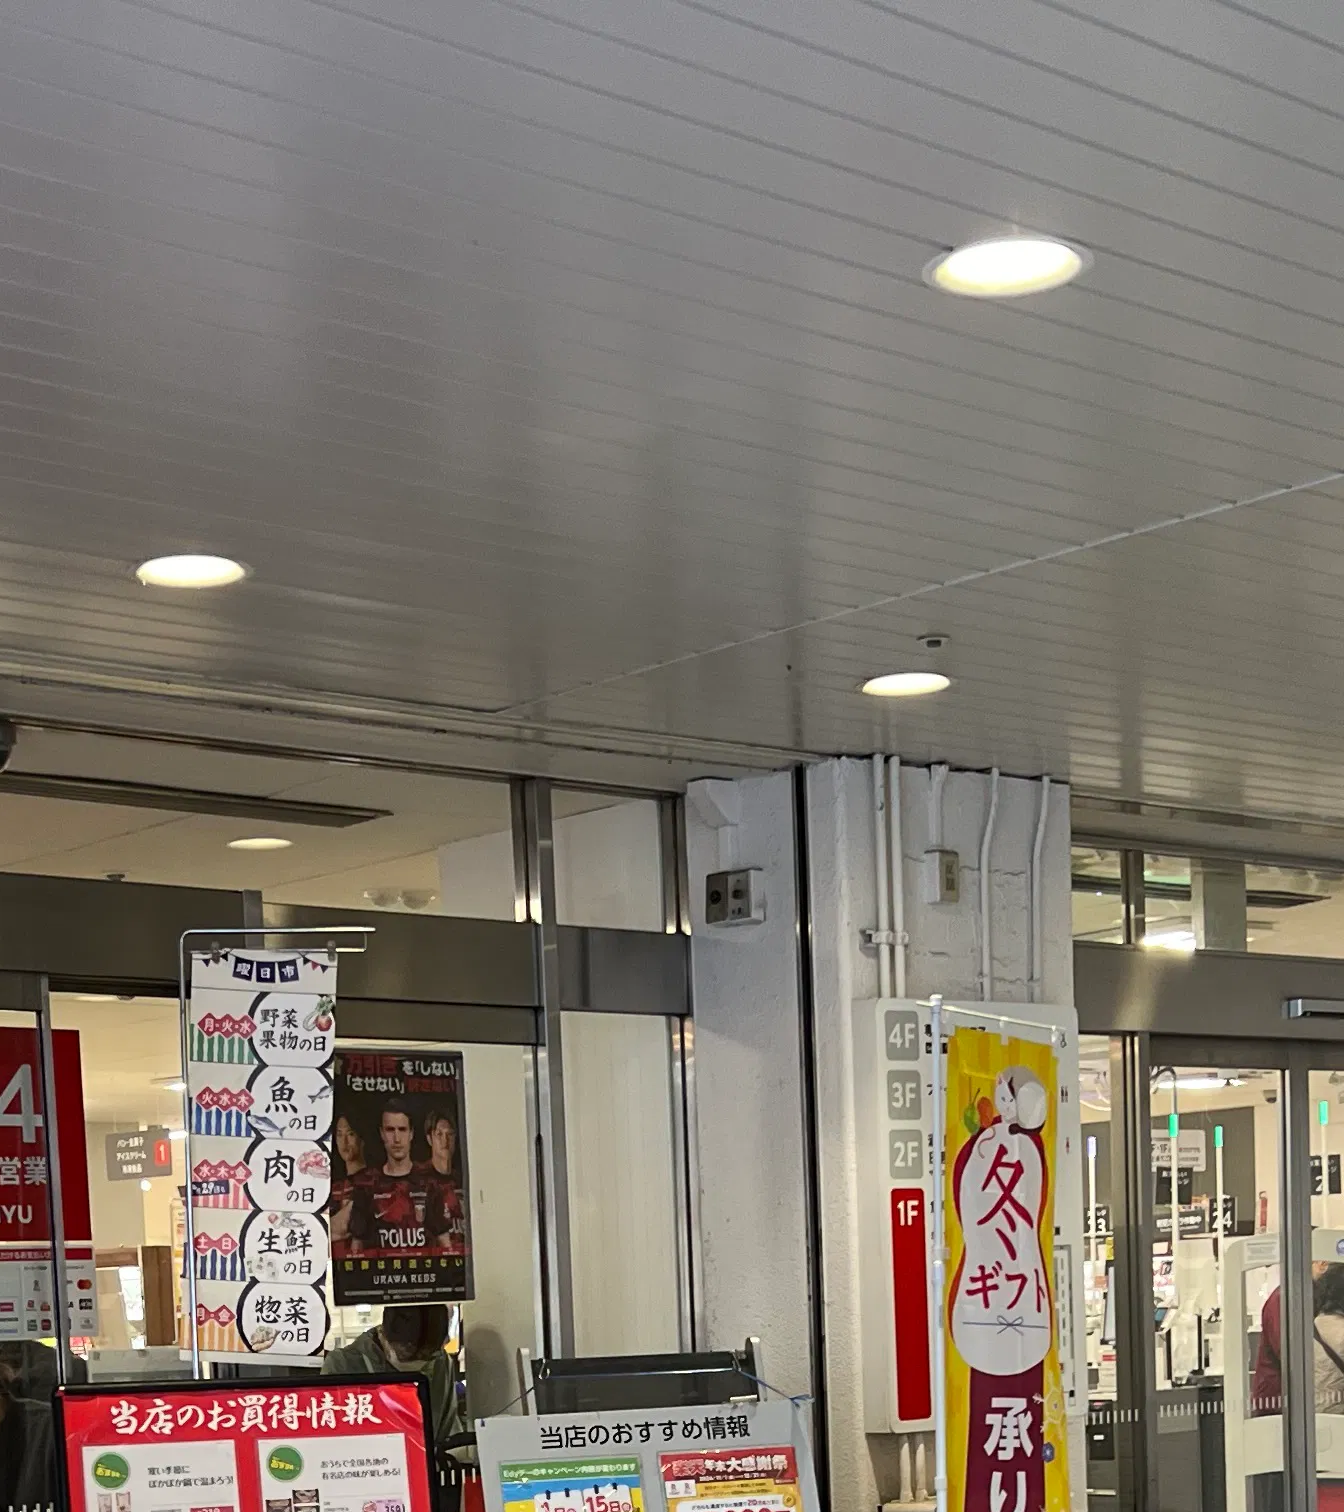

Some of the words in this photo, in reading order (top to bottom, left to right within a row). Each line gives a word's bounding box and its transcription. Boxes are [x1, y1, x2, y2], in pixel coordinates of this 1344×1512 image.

[236, 962, 296, 980] 曜日市
[259, 1008, 299, 1029] 野菜
[259, 1031, 327, 1052] 果物の日
[888, 1022, 916, 1049] 4F
[264, 1076, 298, 1114] 魚
[891, 1081, 916, 1109] 3F
[288, 1115, 317, 1131] の日
[893, 1140, 919, 1168] 2F
[263, 1150, 296, 1187] 肉
[287, 1188, 315, 1203] の日
[976, 1143, 1034, 1261] 冬
[897, 1199, 920, 1227] 1F
[257, 1228, 313, 1256] 生鮮
[378, 1227, 426, 1248] POLUS
[283, 1259, 312, 1275] の日
[373, 1275, 408, 1285] URAWA
[965, 1260, 1047, 1314] ギフト
[255, 1296, 309, 1325] 惣菜
[281, 1328, 310, 1343] の日
[110, 1391, 384, 1436] 当店のお買得情報
[539, 1414, 751, 1450] 当店のおすすめ情報
